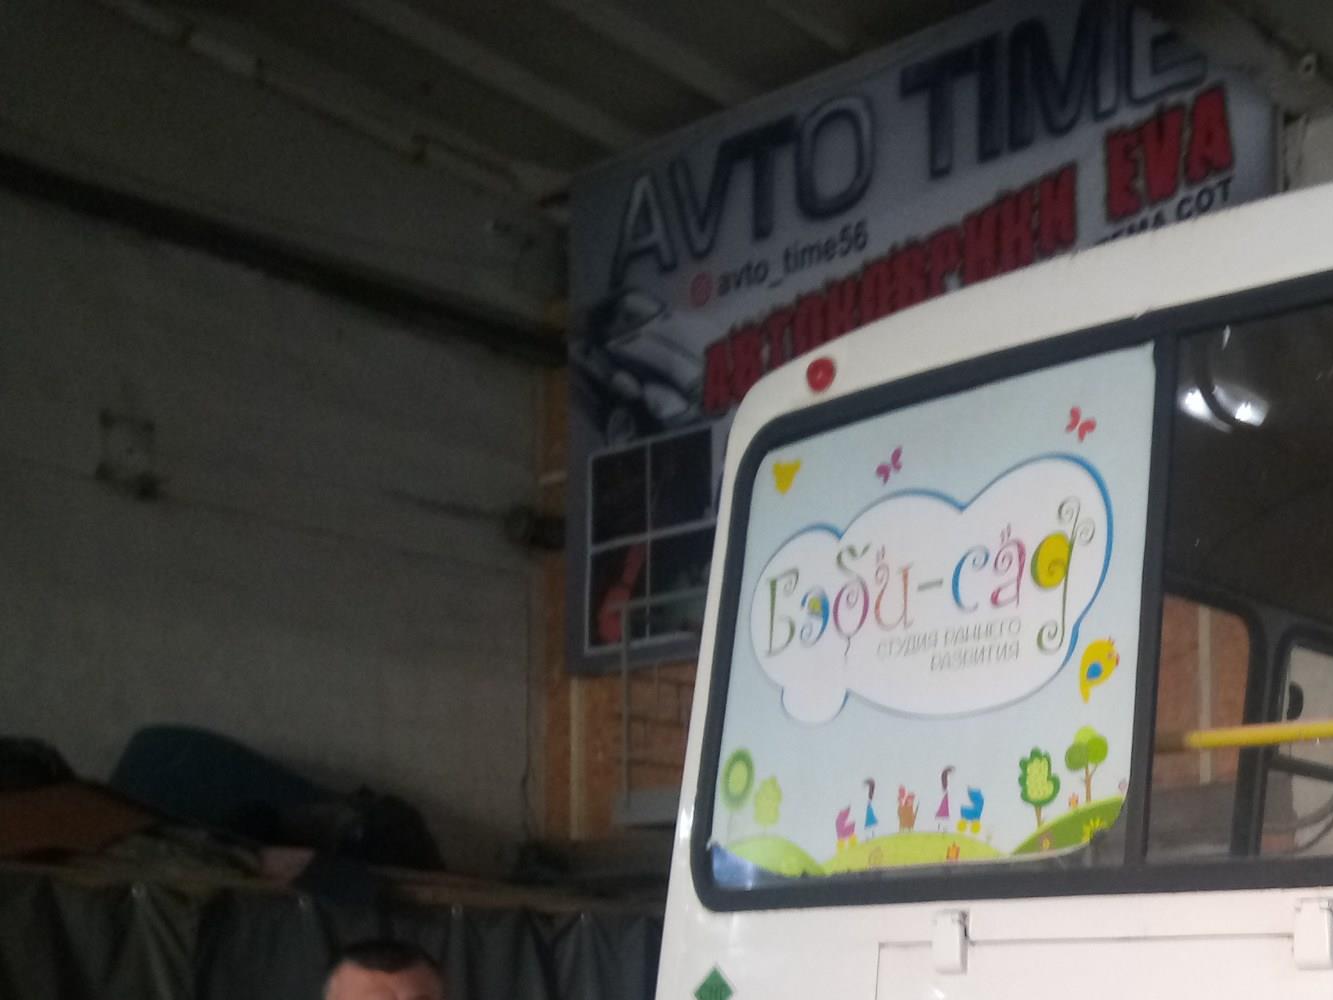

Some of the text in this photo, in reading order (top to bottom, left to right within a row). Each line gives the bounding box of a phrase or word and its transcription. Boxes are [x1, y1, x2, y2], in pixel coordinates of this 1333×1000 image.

[608, 0, 1208, 288] AVTO TIME
[1105, 80, 1236, 226] EVA
[716, 214, 868, 297] avto_time56
